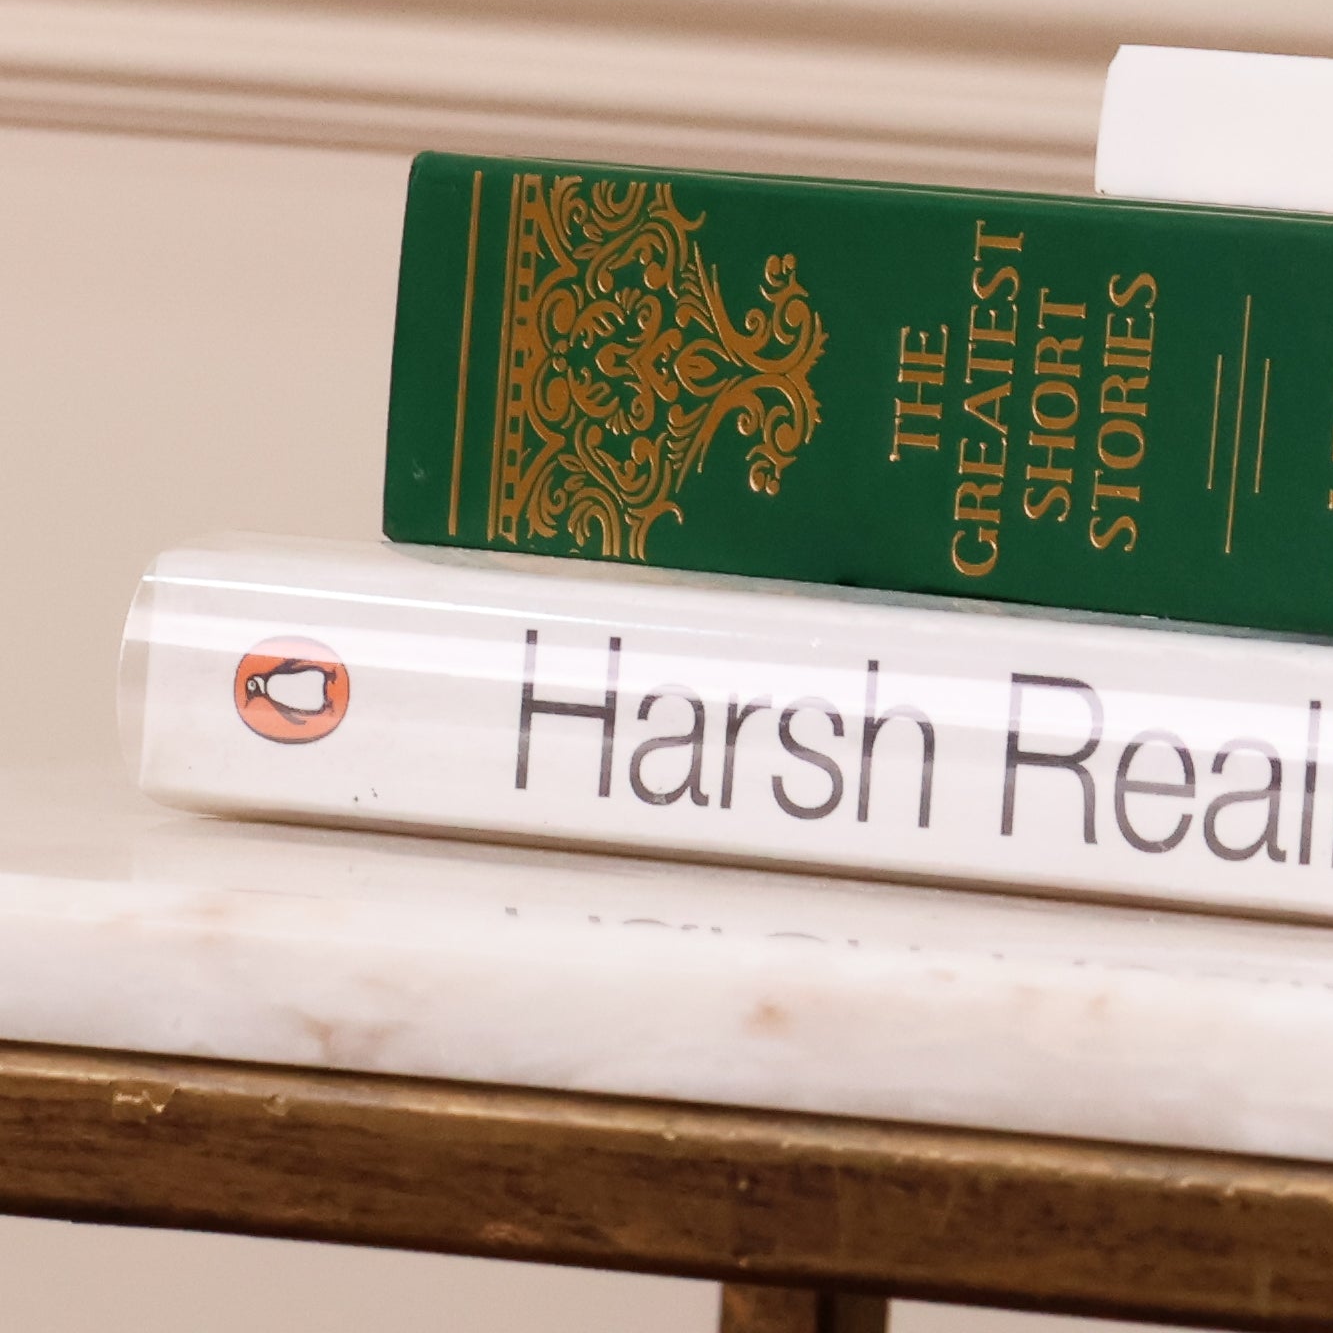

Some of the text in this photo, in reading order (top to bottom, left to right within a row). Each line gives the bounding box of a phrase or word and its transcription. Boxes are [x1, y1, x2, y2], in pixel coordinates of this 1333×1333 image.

[889, 324, 948, 461] THE
[952, 220, 1024, 576] GREATEST
[1023, 288, 1086, 522] SHORT
[1089, 273, 1157, 551] STORIES
[515, 629, 935, 828] Harsh
